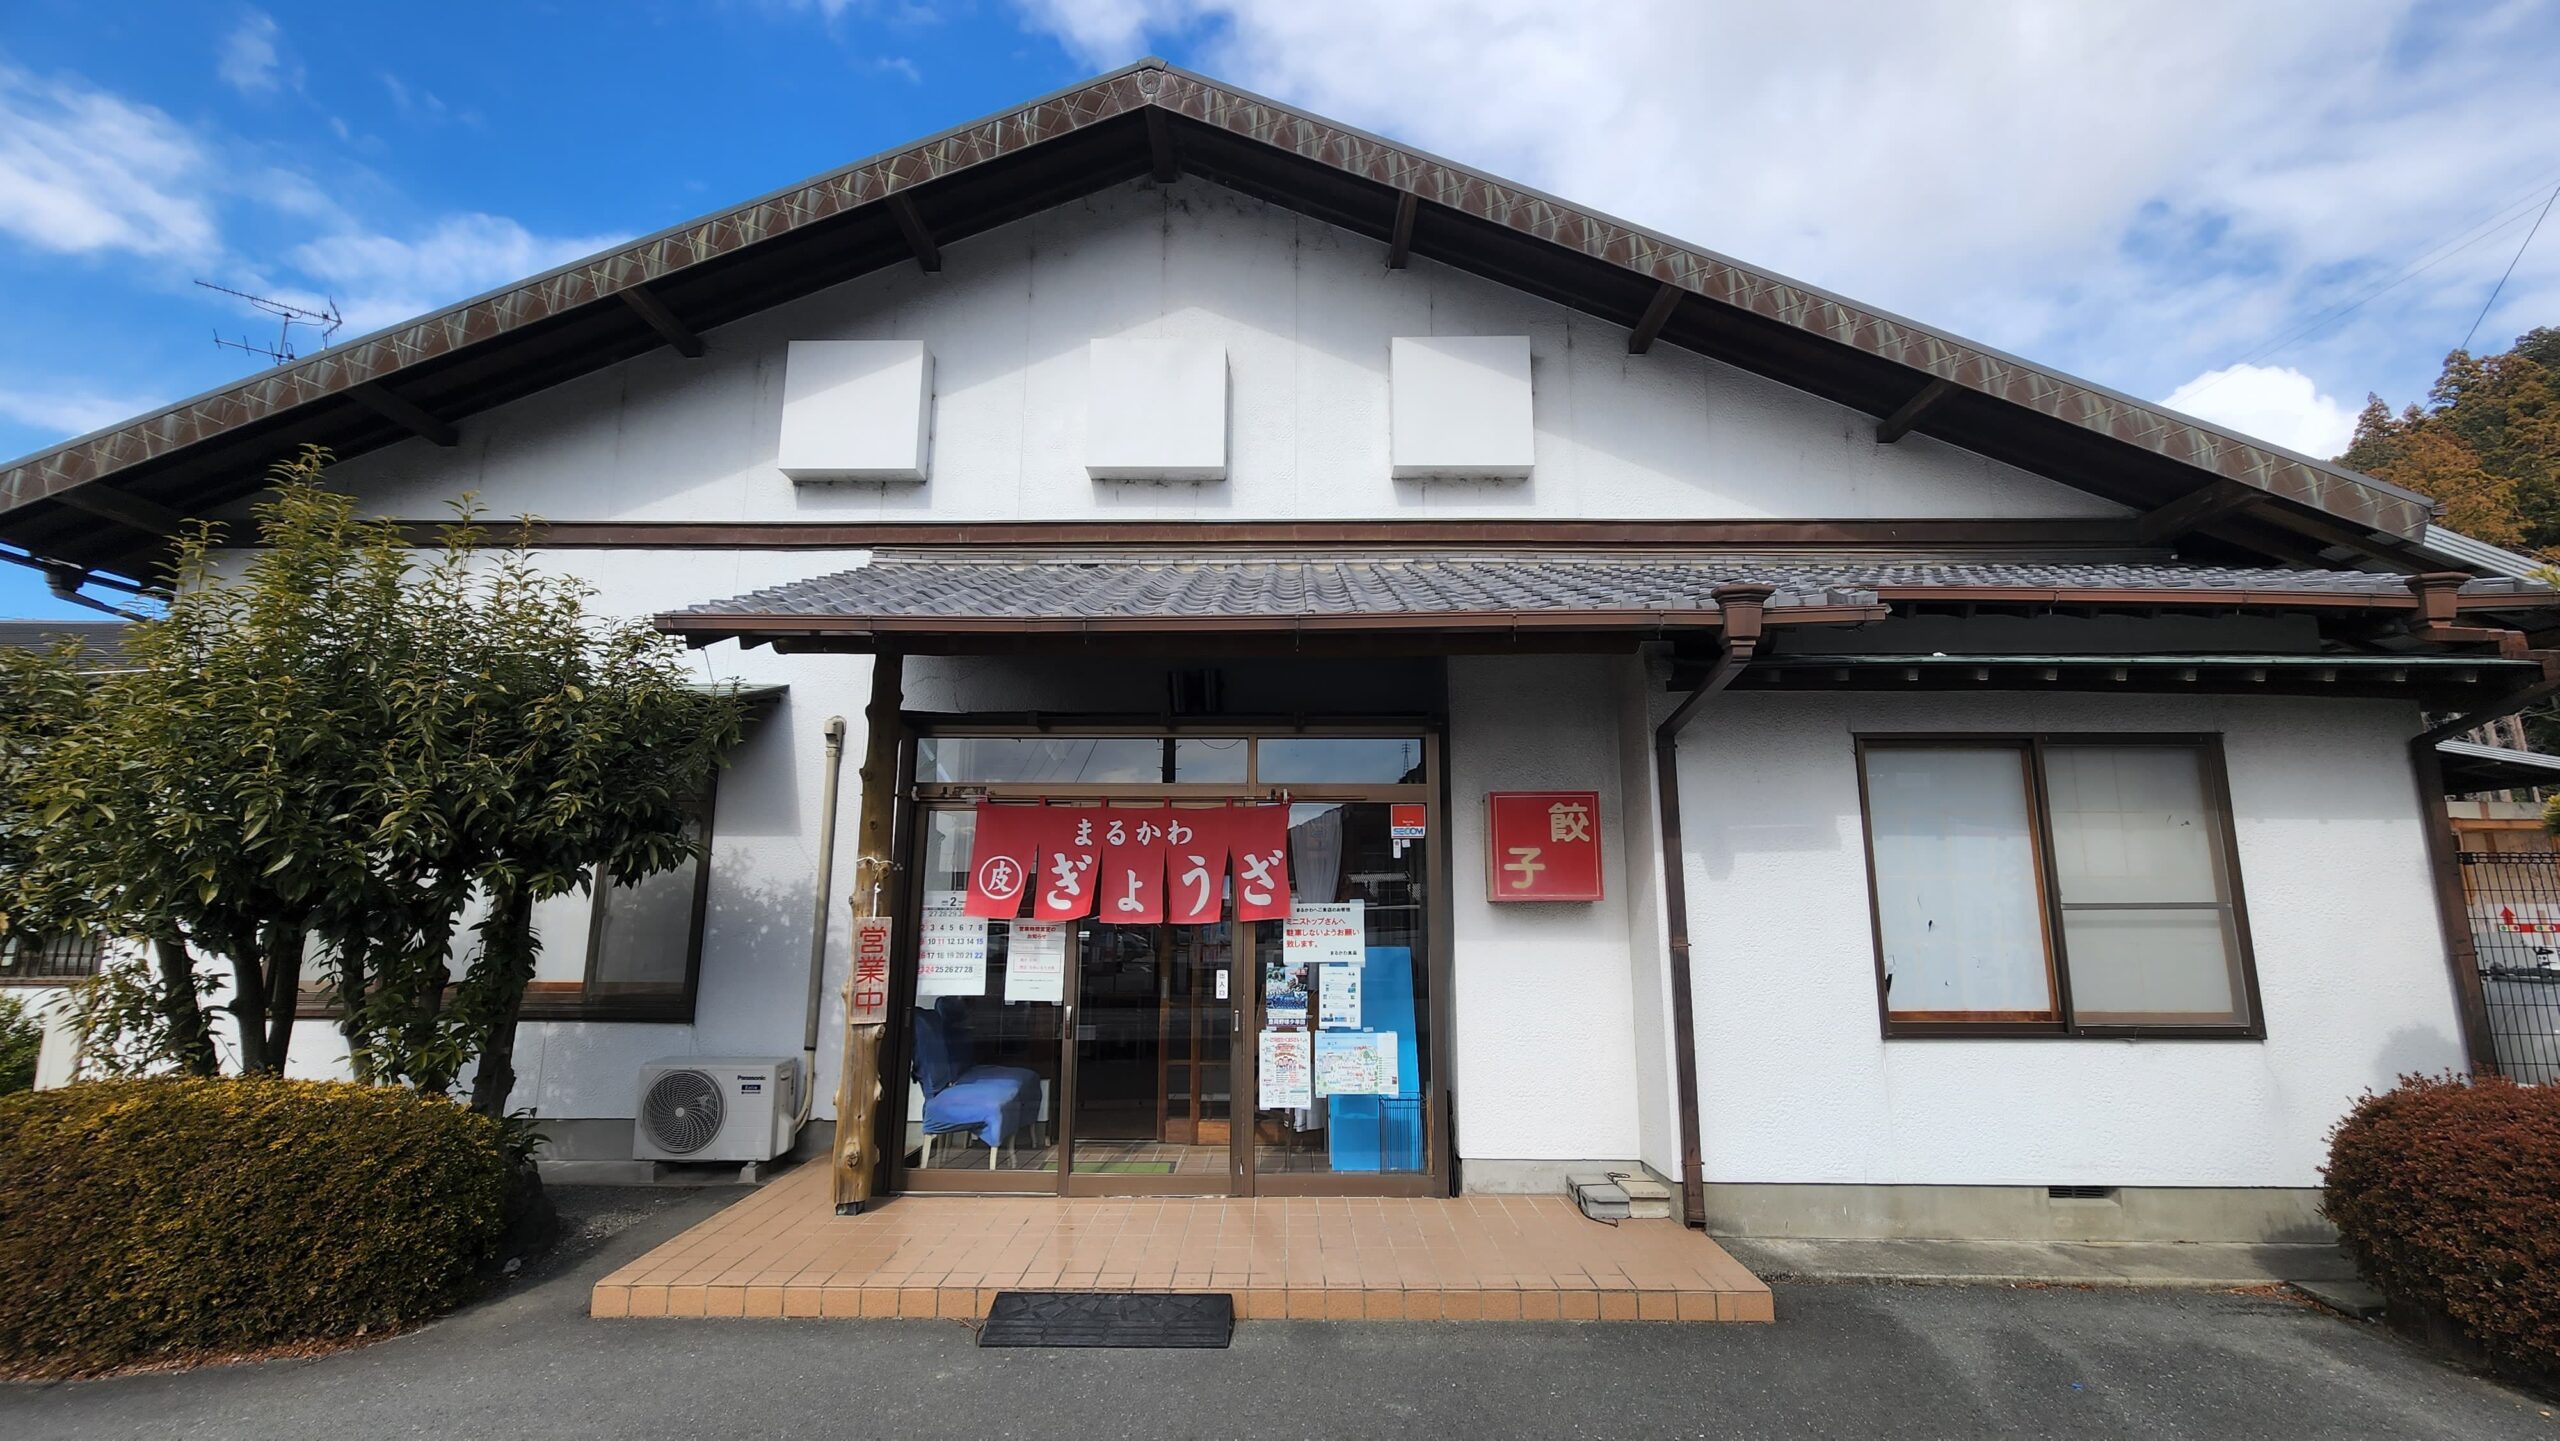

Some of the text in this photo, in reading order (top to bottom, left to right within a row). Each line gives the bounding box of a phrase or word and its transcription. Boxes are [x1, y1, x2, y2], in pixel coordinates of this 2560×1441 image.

[1074, 818, 1193, 846] まるかわ
[1504, 802, 1590, 889] 餃子
[988, 860, 1013, 893] 皮
[1047, 850, 1284, 916] ぎょうざ
[950, 897, 957, 906] 2
[1286, 940, 1318, 948] 致します。
[856, 926, 887, 1015] 営業中
